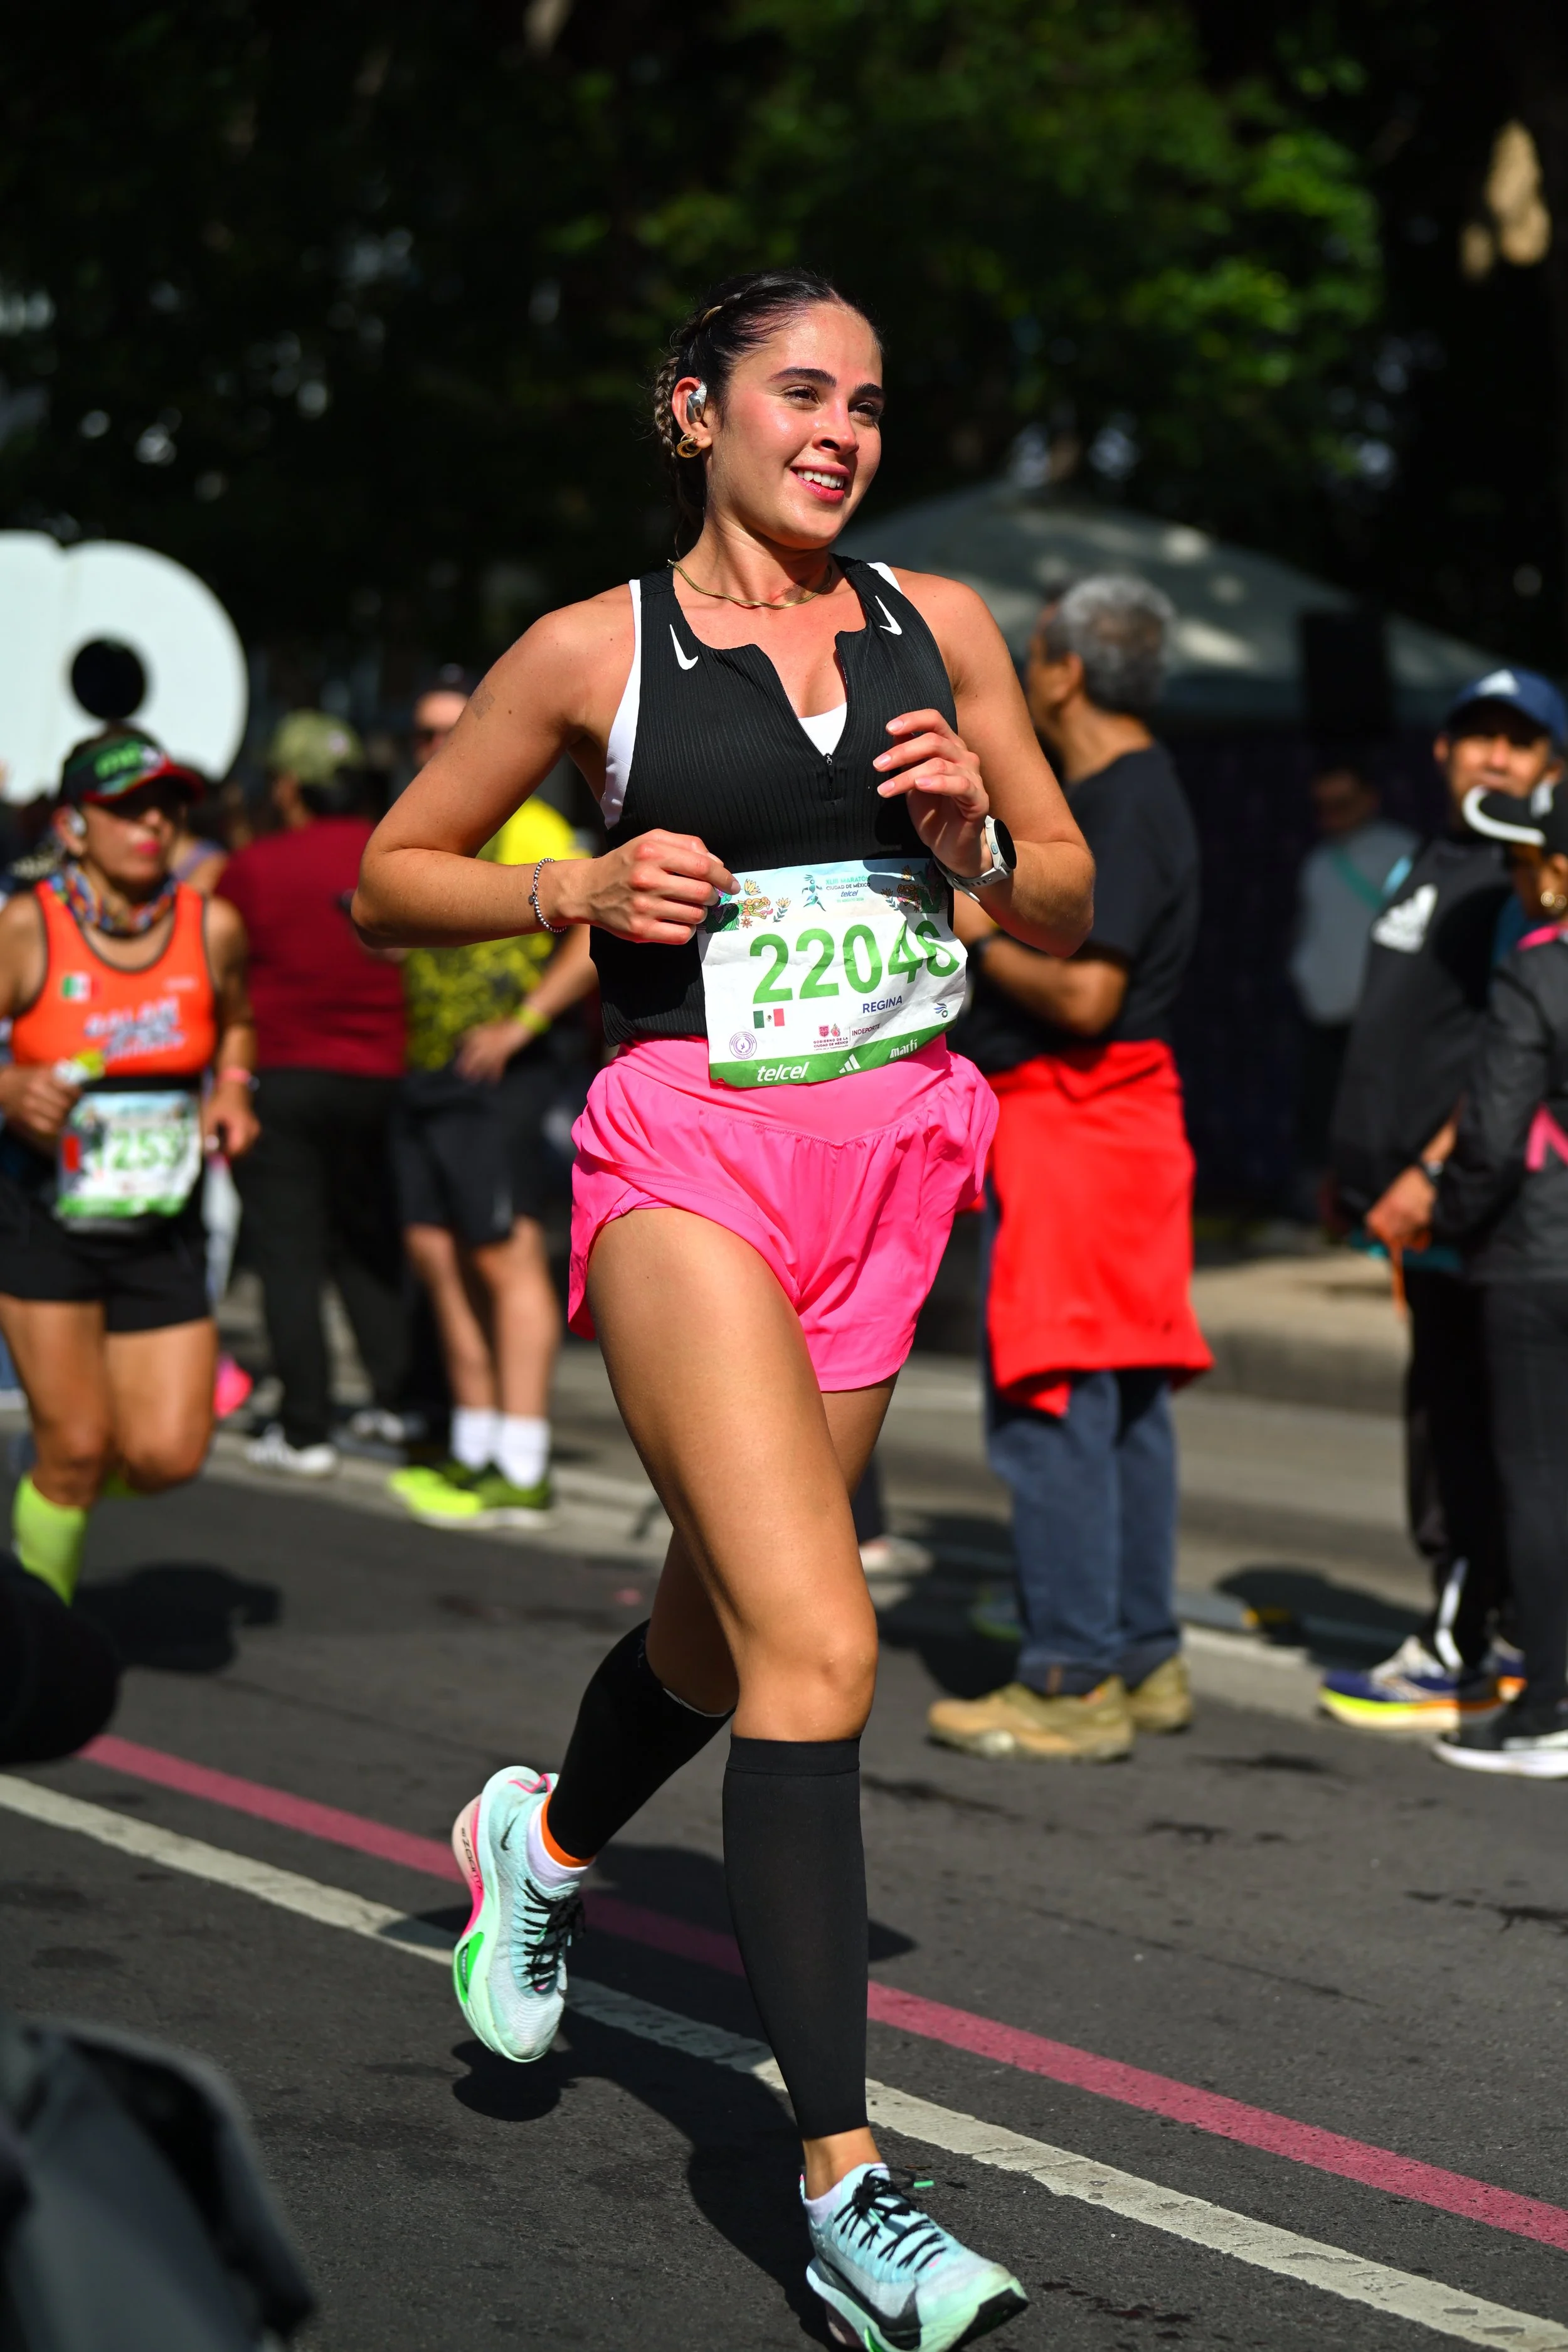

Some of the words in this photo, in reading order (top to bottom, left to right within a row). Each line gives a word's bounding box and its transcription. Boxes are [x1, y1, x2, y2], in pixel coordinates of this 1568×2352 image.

[750, 919, 960, 1004] 22046
[862, 995, 903, 1014] REGINA
[852, 1023, 881, 1036] INDEPORTE
[889, 1039, 918, 1059] martí
[757, 1061, 810, 1082] telcel
